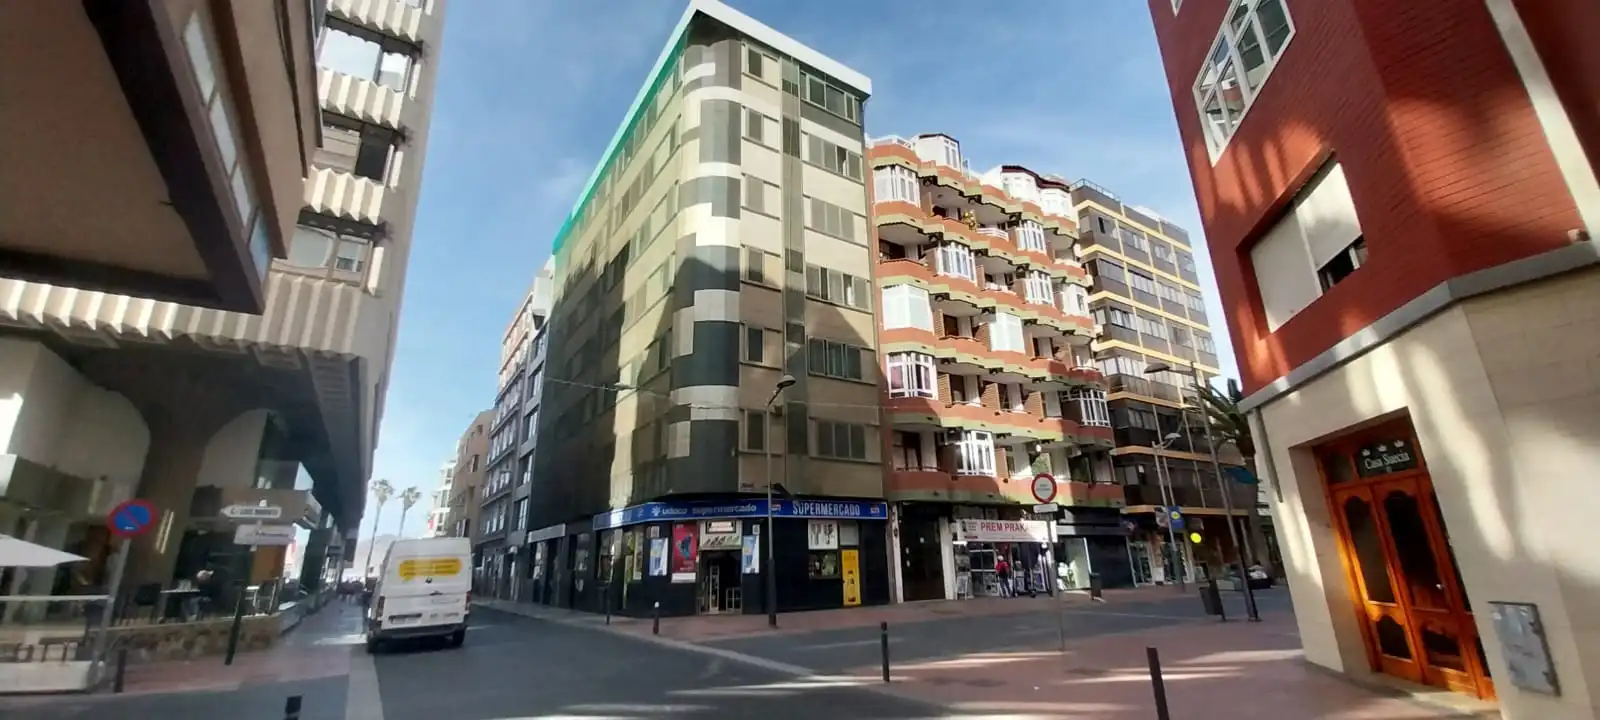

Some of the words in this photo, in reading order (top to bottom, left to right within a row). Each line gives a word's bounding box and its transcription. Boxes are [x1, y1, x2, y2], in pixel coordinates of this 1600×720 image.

[1364, 457, 1383, 470] Casa
[692, 503, 757, 516] supermercado
[792, 500, 861, 516] SUPERMERCADO
[980, 521, 1003, 532] PREM
